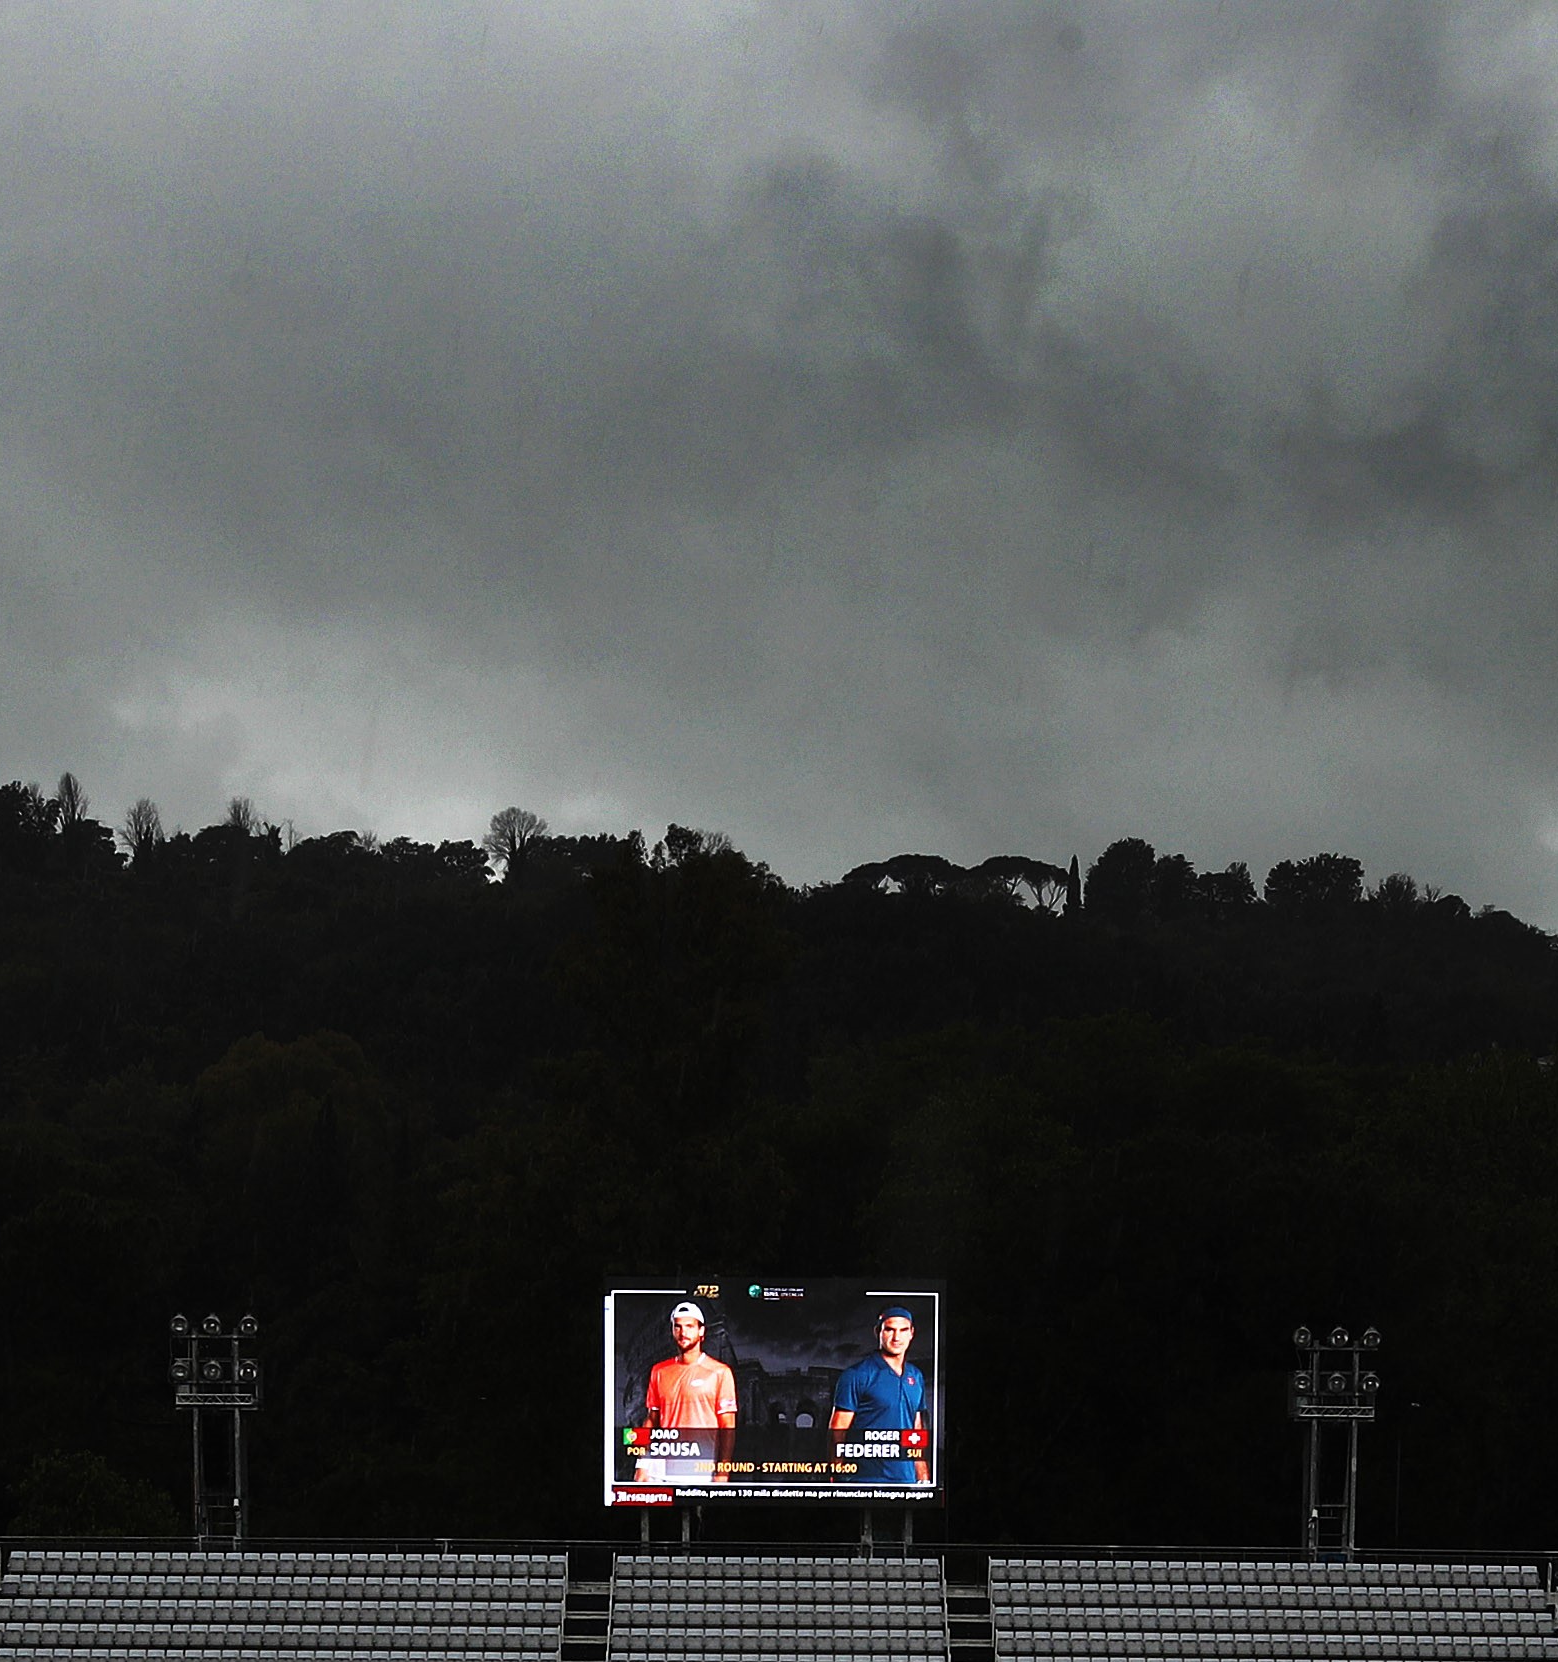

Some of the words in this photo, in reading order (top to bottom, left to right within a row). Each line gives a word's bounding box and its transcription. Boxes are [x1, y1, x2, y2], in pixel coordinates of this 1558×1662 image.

[865, 1430, 900, 1441] ROGER
[627, 1447, 646, 1456] POR
[650, 1443, 700, 1456] SOUSA
[836, 1444, 900, 1458] FEDERER
[907, 1449, 922, 1458] SUI
[717, 1462, 755, 1473] ROUND
[762, 1462, 813, 1473] STARTING
[814, 1463, 828, 1473] AT
[830, 1463, 857, 1474] 16:00
